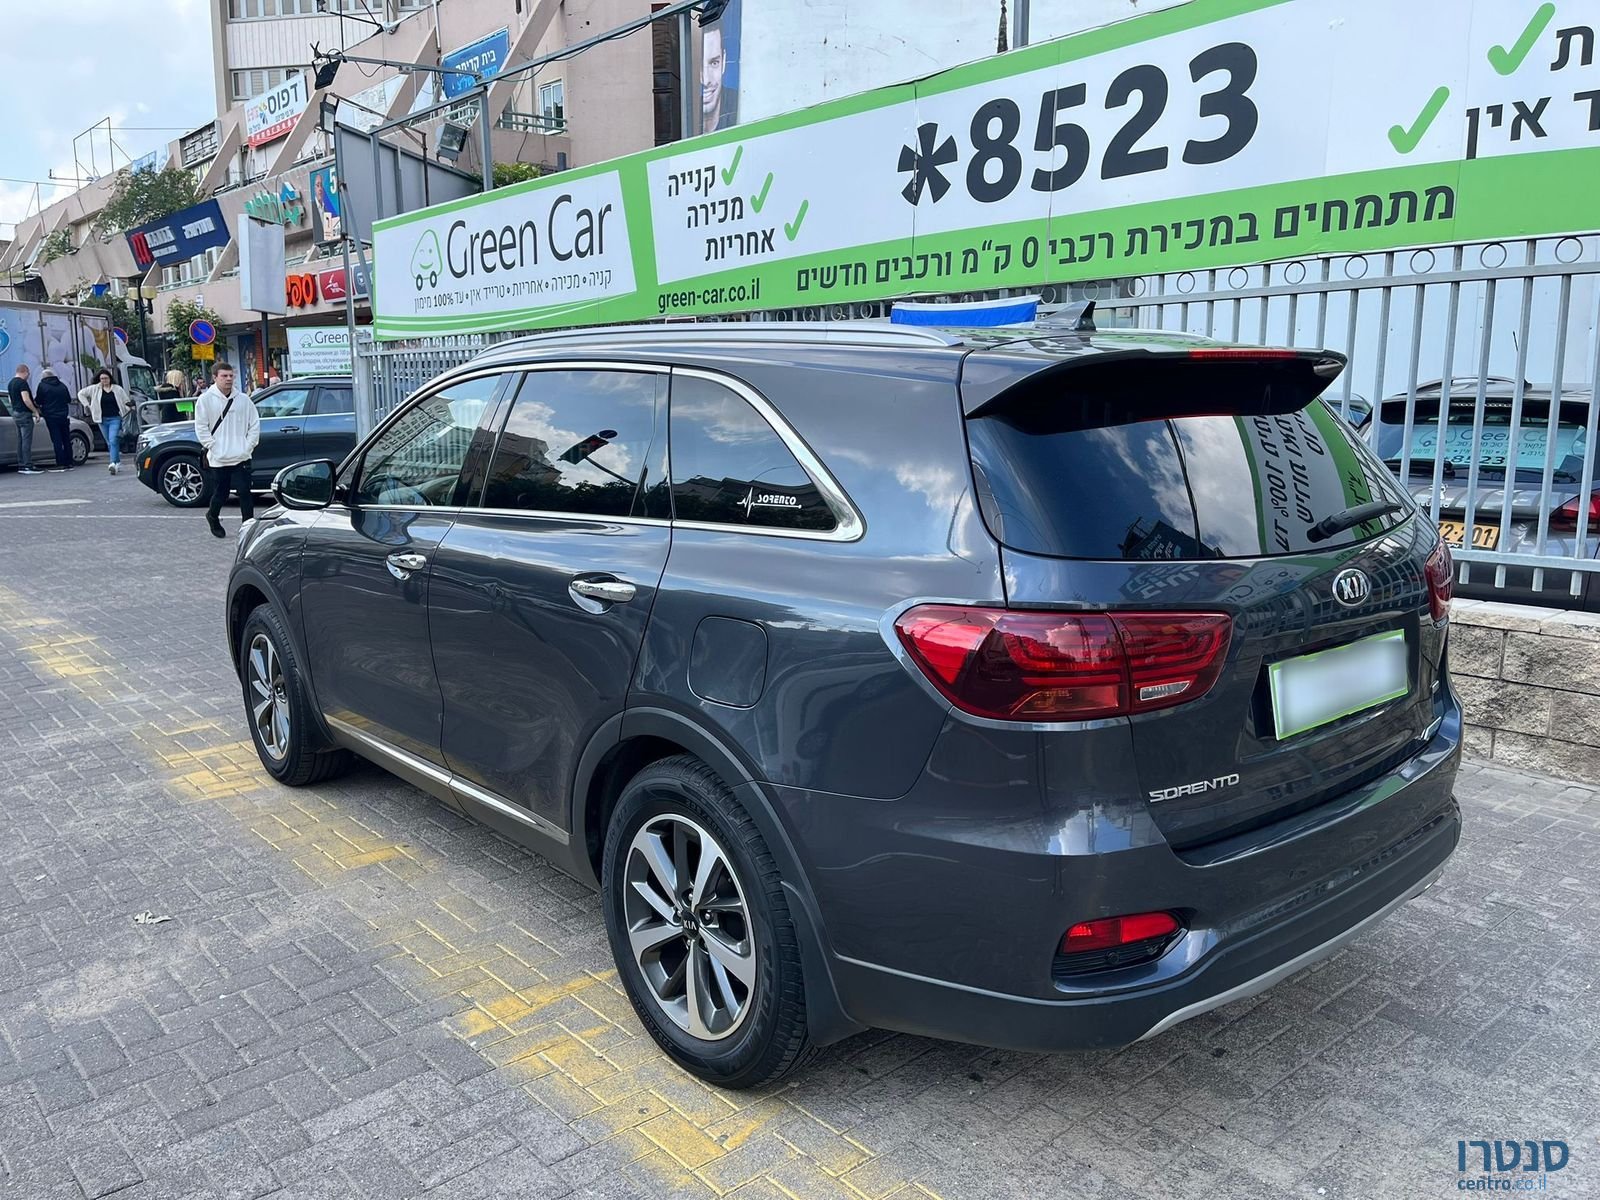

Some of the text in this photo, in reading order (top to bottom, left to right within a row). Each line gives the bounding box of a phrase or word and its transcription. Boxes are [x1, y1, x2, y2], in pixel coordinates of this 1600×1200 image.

[267, 83, 298, 114] דפוס
[1466, 96, 1552, 160] אין
[668, 164, 717, 198] קנייה
[686, 195, 744, 229] מכירה
[1274, 184, 1455, 237] מתמחים
[446, 194, 612, 279] Green Car
[705, 228, 775, 261] אחריות
[1047, 231, 1114, 265] רכבי
[1126, 211, 1260, 256] במכירת
[876, 249, 954, 283] ורכבים
[1021, 237, 1038, 268] 0
[512, 279, 543, 297] אחריות
[551, 273, 580, 291] מכירה
[796, 260, 868, 292] חדשים
[433, 292, 454, 307] 100%
[657, 278, 761, 313] green-car.co.il
[314, 331, 349, 344] Green
[1340, 572, 1368, 600] KIA
[1149, 773, 1240, 803] SORENTO
[683, 919, 697, 931] KIA
